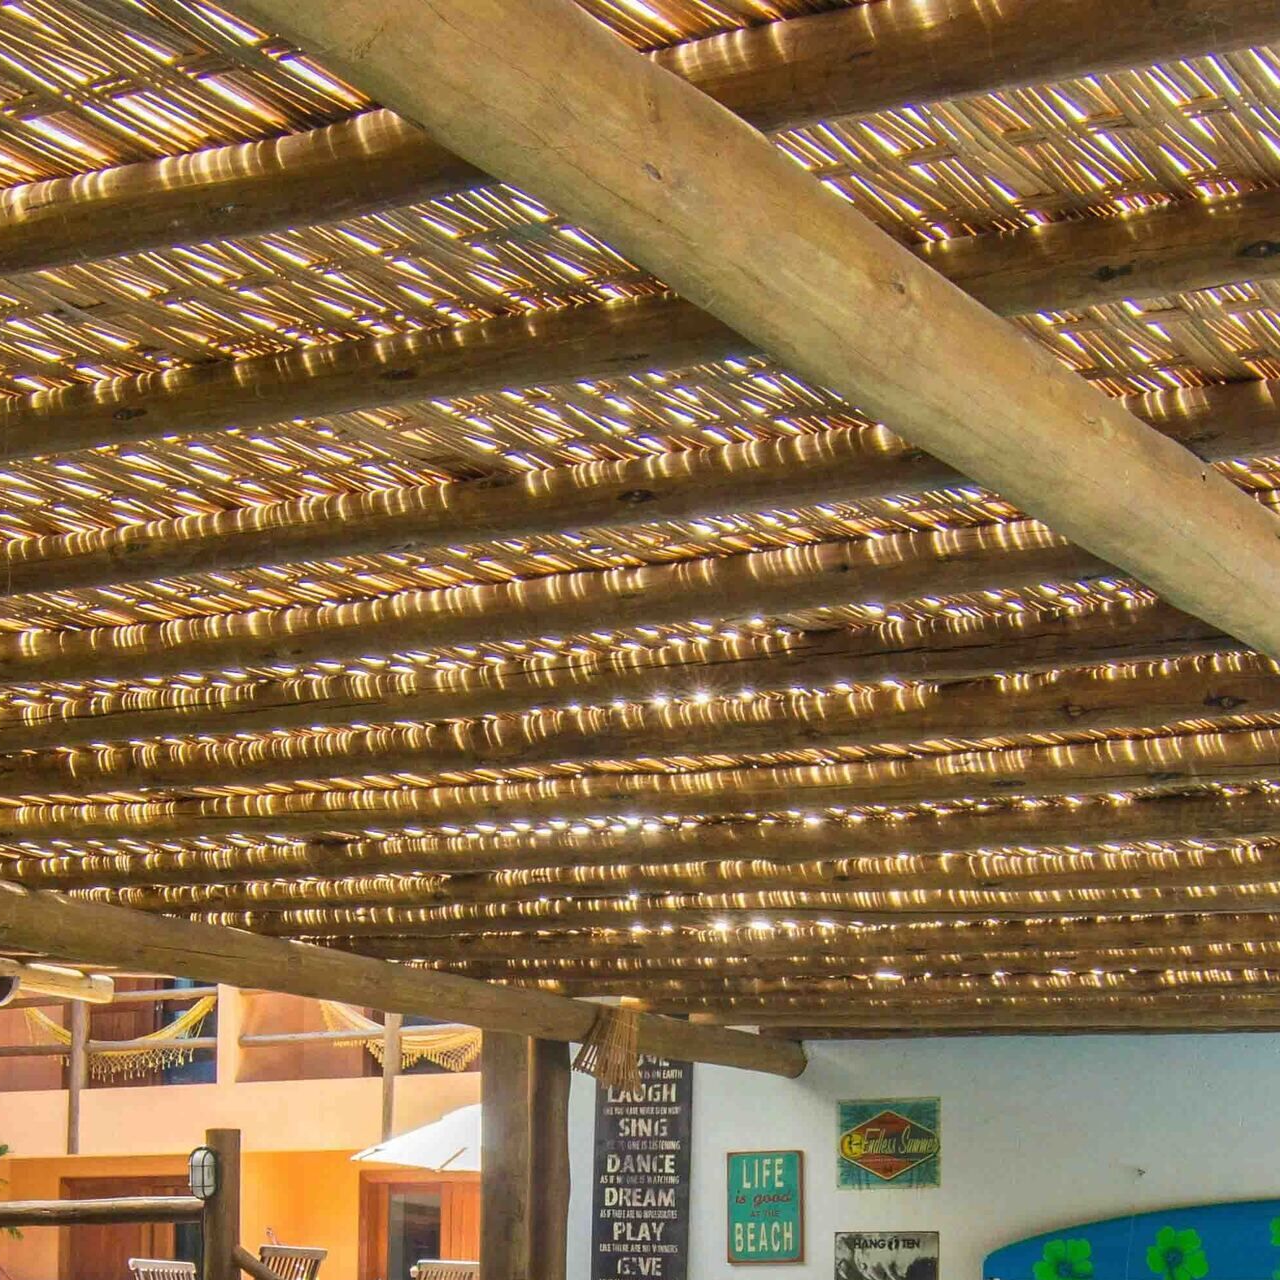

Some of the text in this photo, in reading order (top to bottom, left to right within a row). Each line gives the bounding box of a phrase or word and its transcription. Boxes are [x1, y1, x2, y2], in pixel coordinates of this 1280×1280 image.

[663, 1069, 682, 1079] EARTH
[608, 1083, 676, 1102] LAUGH
[618, 1118, 668, 1137] SING
[863, 1124, 940, 1154] Endless Summer
[606, 1154, 675, 1173] DANCE
[742, 1158, 784, 1188] LIFE
[647, 1175, 680, 1184] WATCHING
[604, 1187, 676, 1207] DREAM
[735, 1189, 792, 1207] is good
[613, 1221, 665, 1241] PLAY
[735, 1221, 793, 1252] BEACH
[853, 1239, 921, 1249] HANG TEN
[617, 1256, 662, 1276] GIVE
